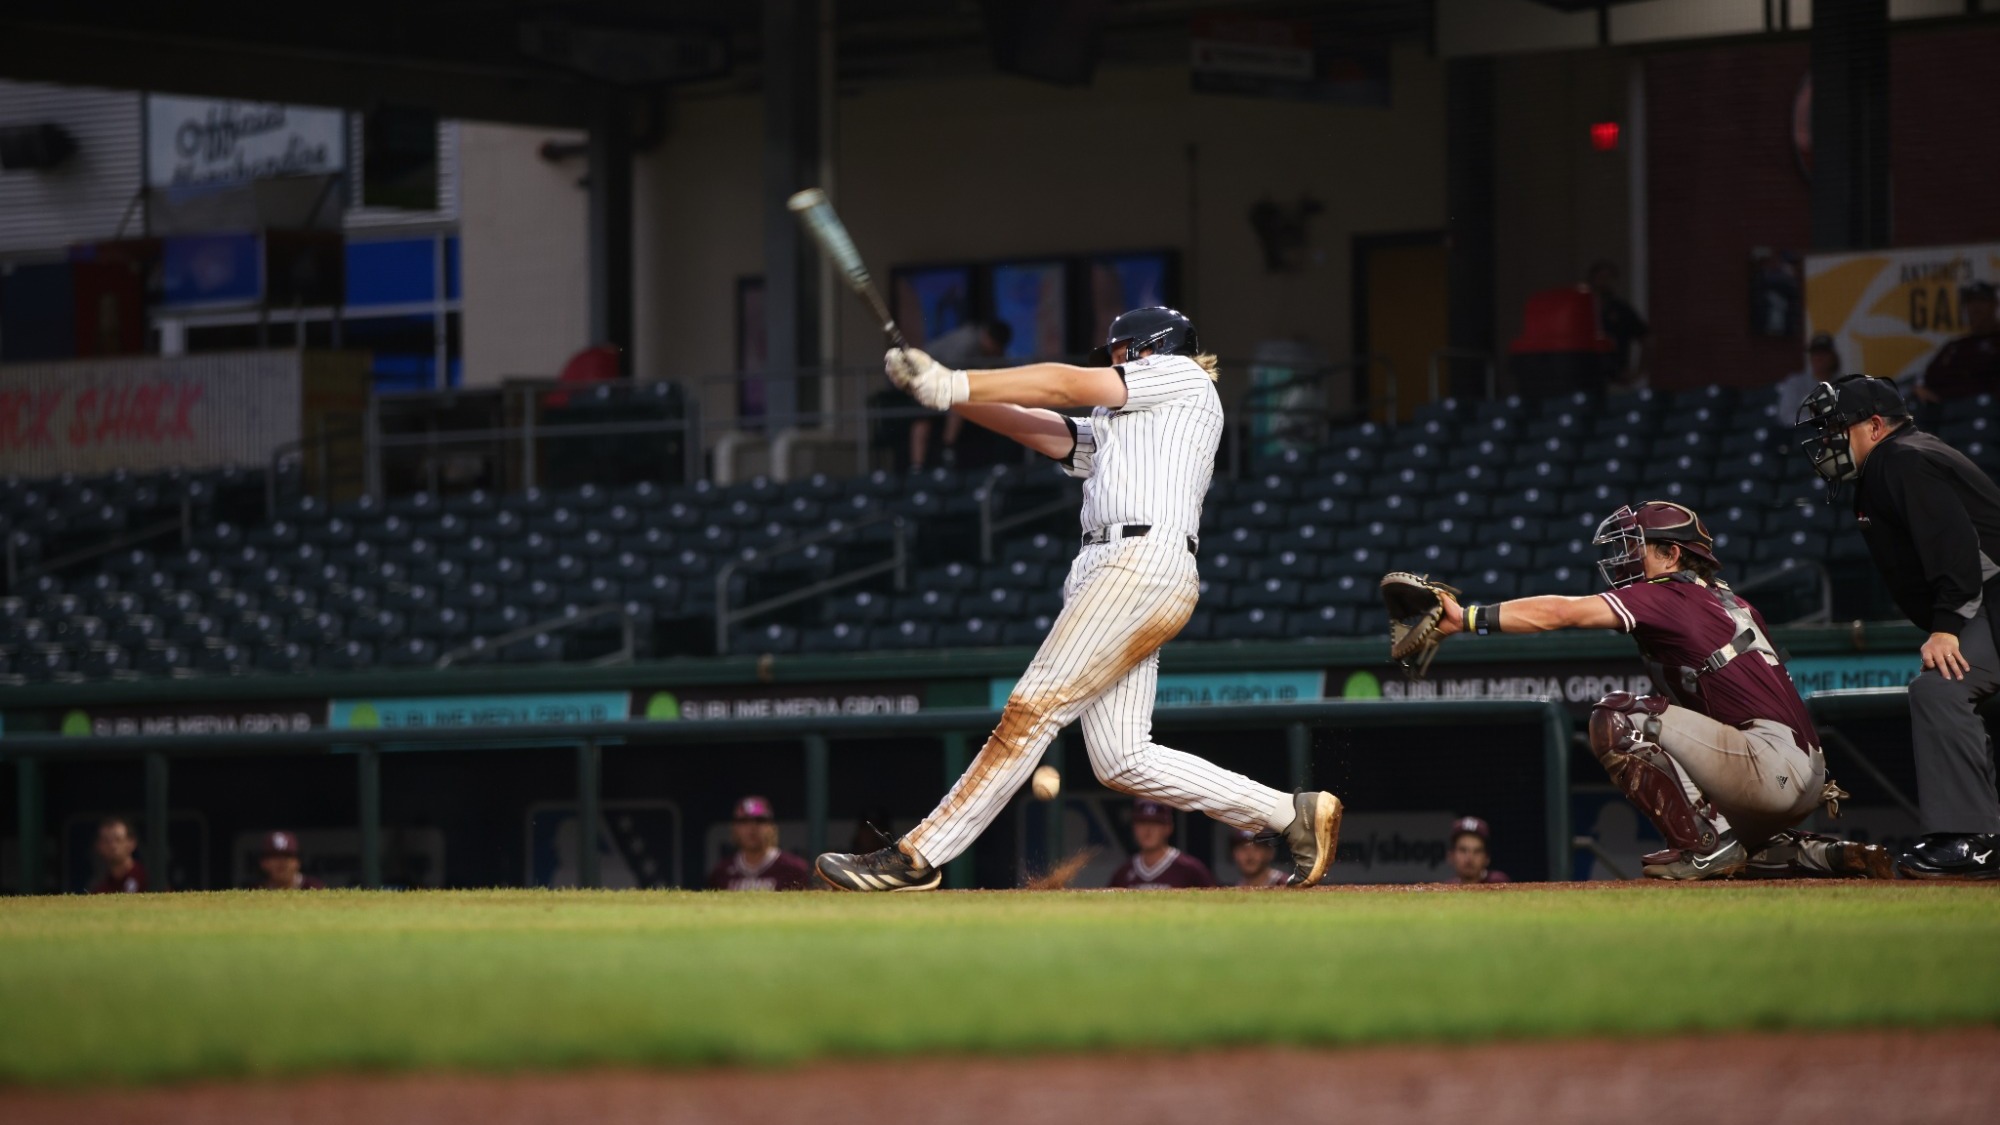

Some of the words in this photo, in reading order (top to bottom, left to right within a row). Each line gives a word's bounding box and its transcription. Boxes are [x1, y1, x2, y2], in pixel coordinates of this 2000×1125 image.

[69, 381, 204, 446] SHACK
[1487, 677, 1564, 702] MEDIA
[1565, 674, 1652, 703] GROUP
[1337, 832, 1446, 868] m/shop
